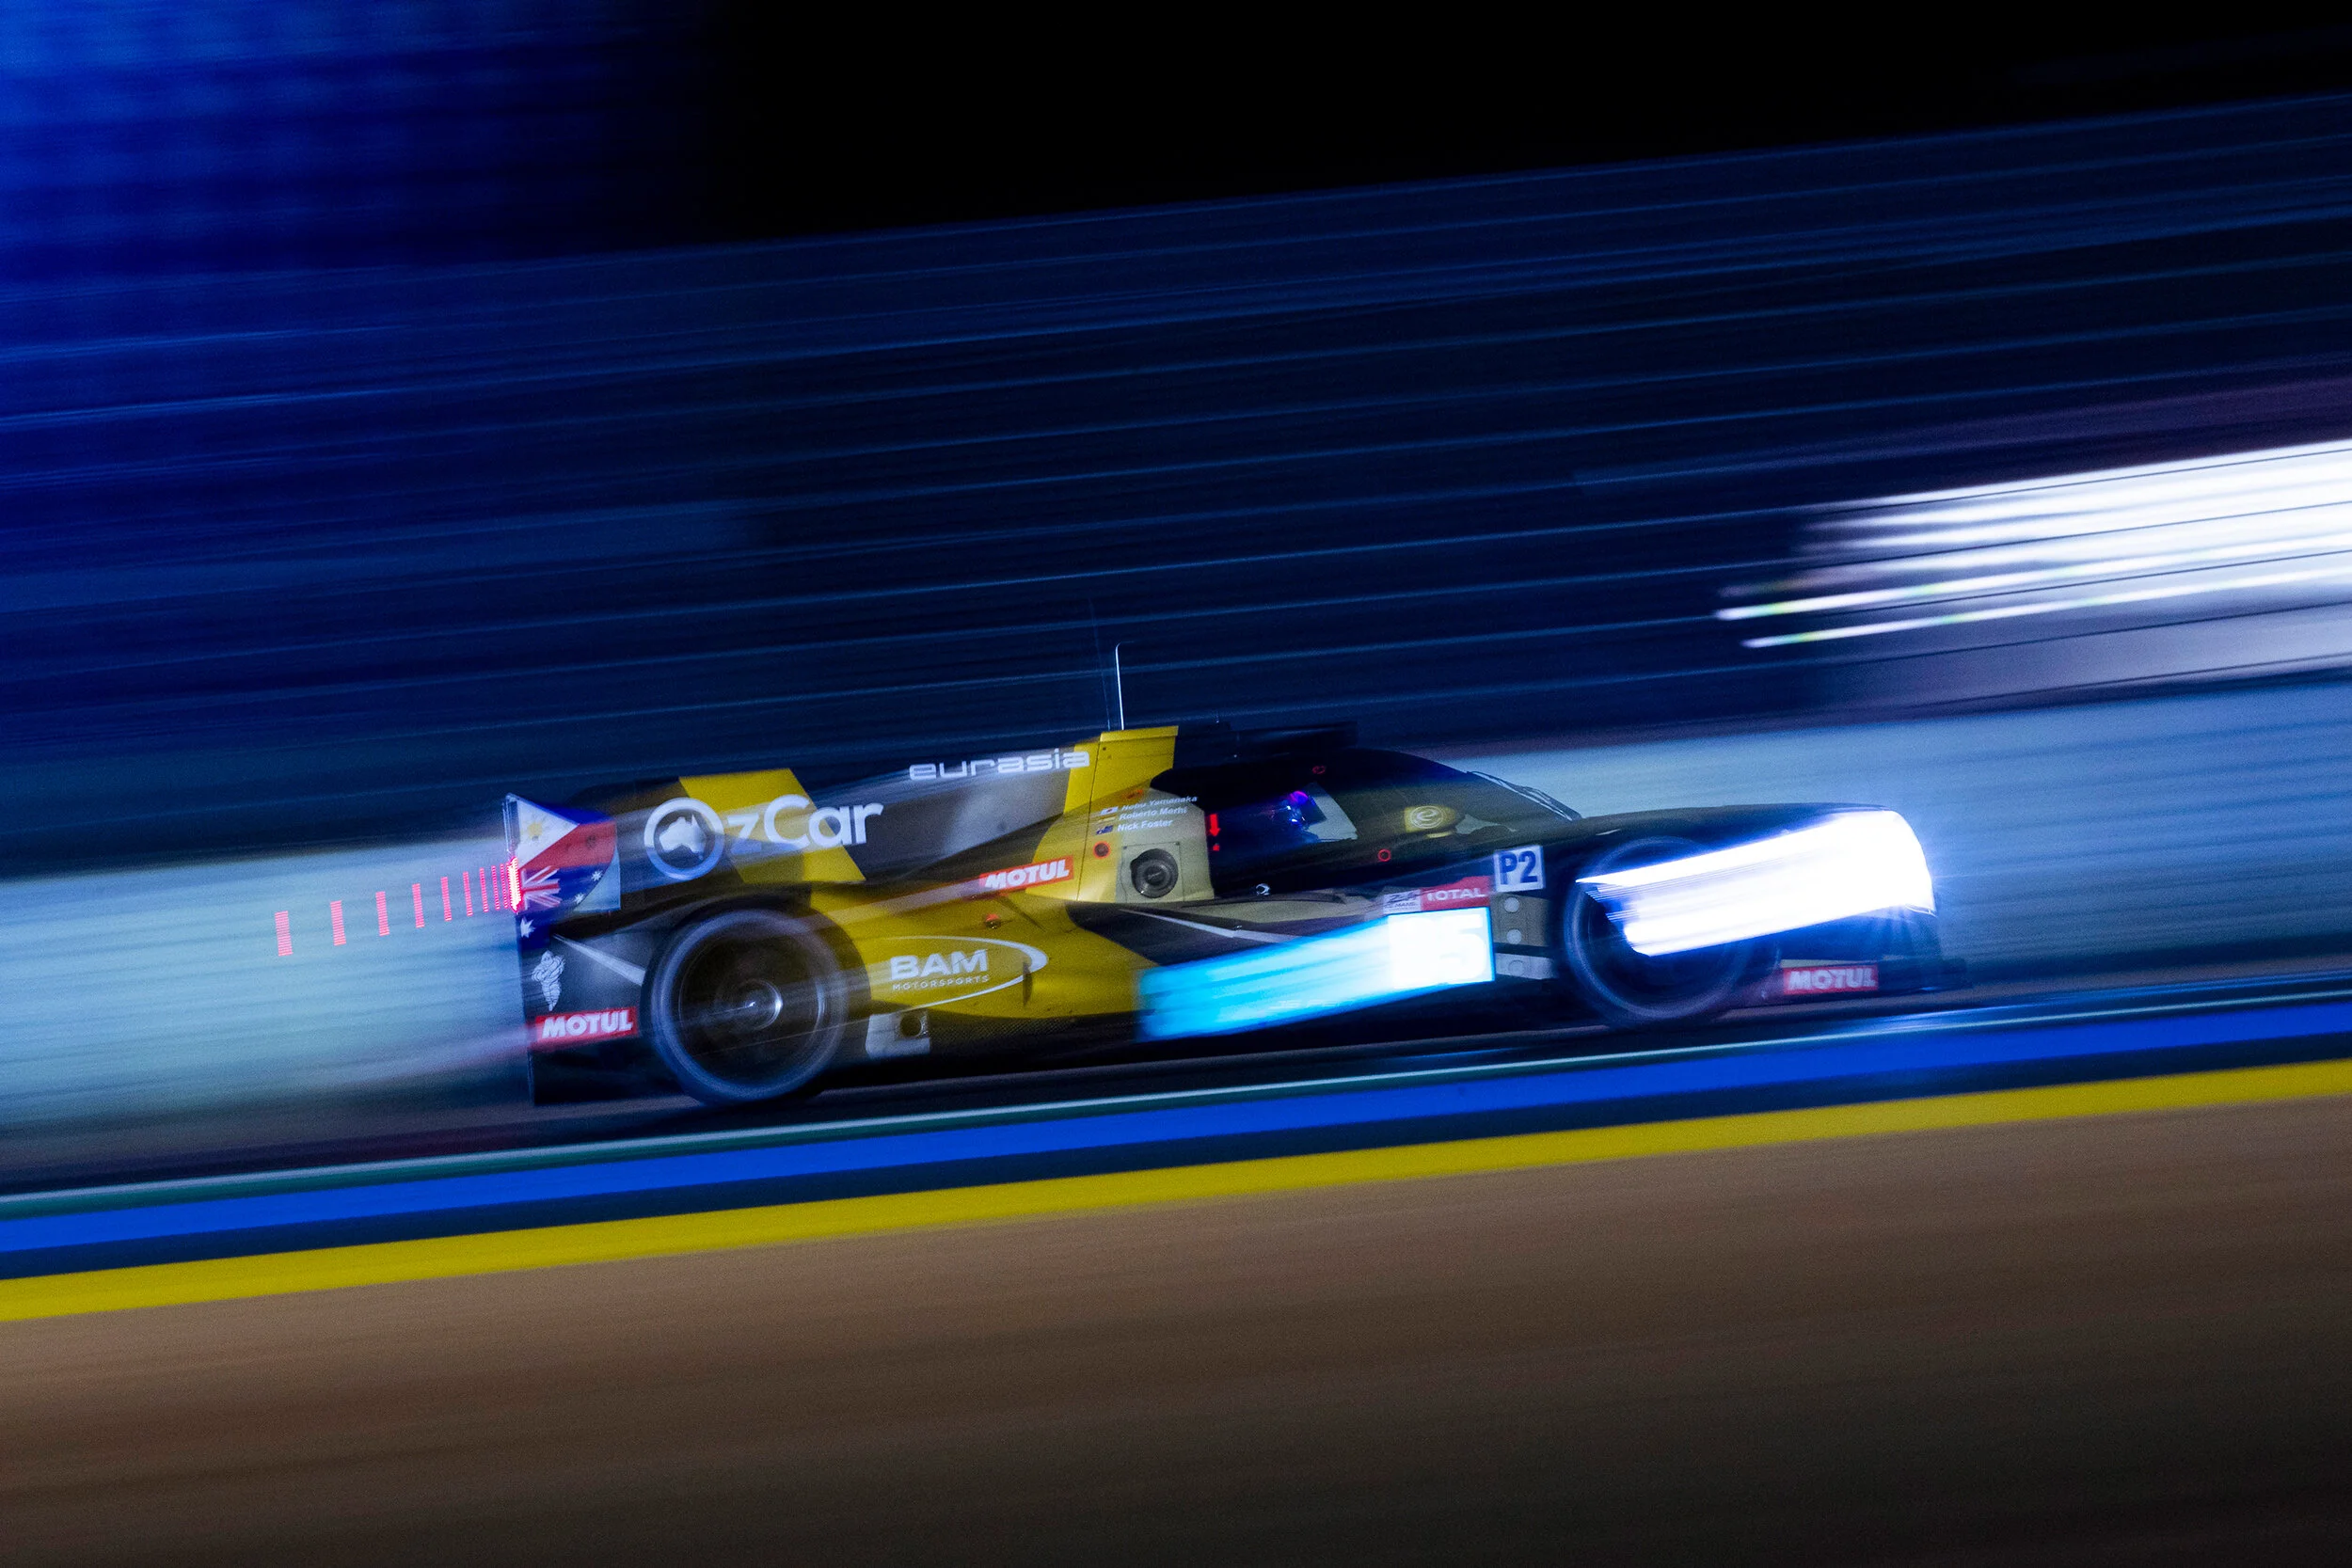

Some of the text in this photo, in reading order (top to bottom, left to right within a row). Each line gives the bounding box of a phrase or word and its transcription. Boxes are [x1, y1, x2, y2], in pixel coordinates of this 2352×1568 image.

[909, 748, 1090, 781] eurasia
[644, 794, 884, 880] OzCar
[1118, 819, 1174, 832] Nick Foster
[984, 859, 1070, 889] MOTUL
[1500, 850, 1538, 885] P2
[890, 948, 988, 981] BAM
[1789, 967, 1876, 990] MOTUL
[892, 974, 990, 990] MOTORSPORTS
[541, 1009, 633, 1038] MOTUL
